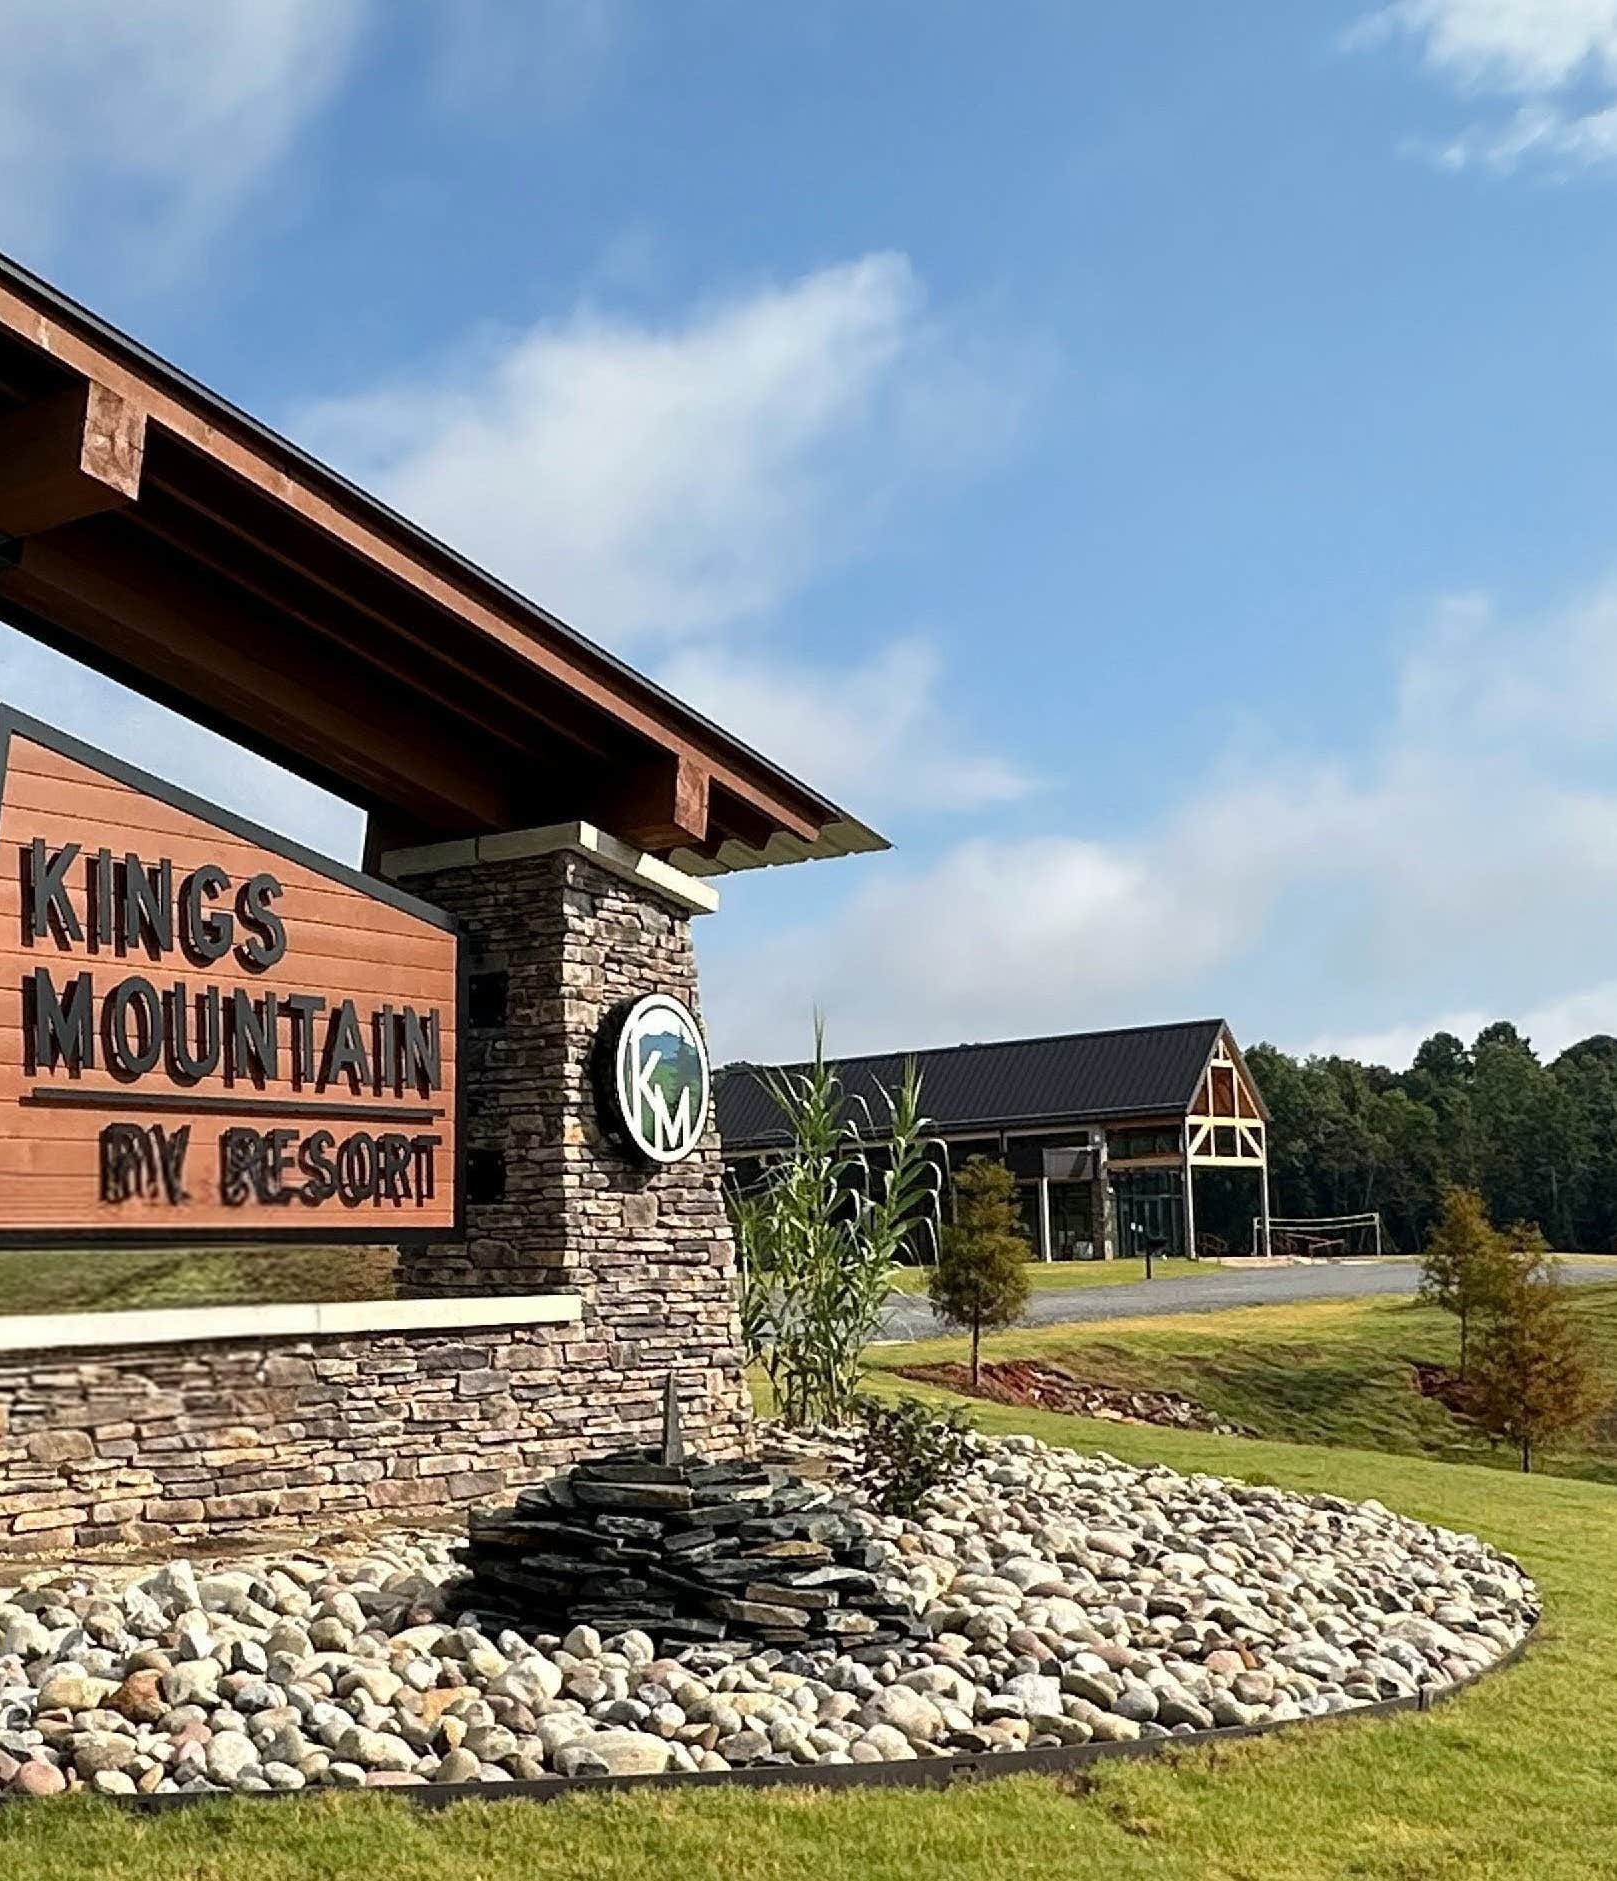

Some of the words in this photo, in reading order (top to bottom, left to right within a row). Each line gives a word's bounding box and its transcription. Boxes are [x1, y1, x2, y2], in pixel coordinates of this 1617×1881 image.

[30, 836, 285, 970] KINGS
[30, 966, 442, 1092] MOUNTAIN
[101, 1122, 191, 1205] RV
[220, 1127, 443, 1206] RESORT
